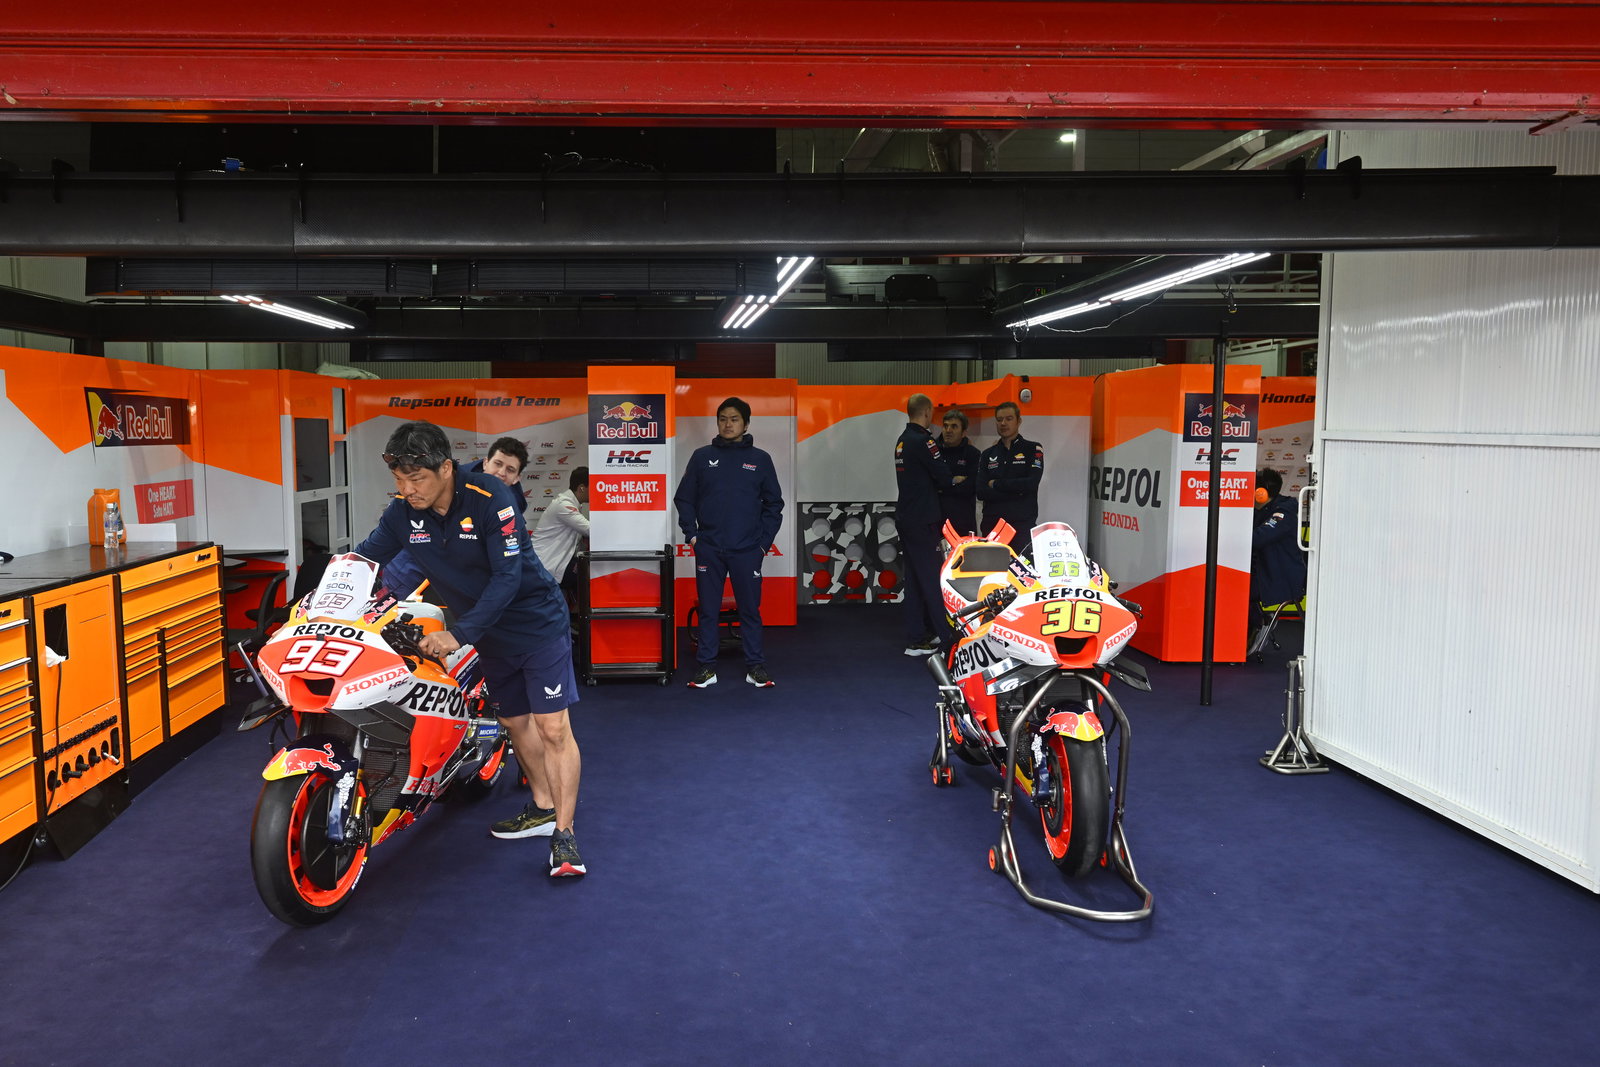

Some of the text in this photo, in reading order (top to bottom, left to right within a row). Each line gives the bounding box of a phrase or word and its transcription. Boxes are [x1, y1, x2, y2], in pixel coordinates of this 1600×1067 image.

[388, 395, 561, 409] Repsol Honda Team
[1261, 393, 1315, 403] Honda
[125, 405, 173, 439] Red Bull
[597, 422, 657, 438] Red Bull
[1191, 421, 1250, 437] Re Bull
[606, 450, 651, 464] HRC
[596, 481, 659, 492] One HEART.
[1089, 466, 1162, 508] REPSOL
[1187, 477, 1248, 489] One EART.
[148, 488, 159, 503] One
[606, 493, 652, 504] Satu HATI.
[1196, 489, 1210, 500] Sat
[1102, 511, 1139, 532] HONDA
[1049, 561, 1080, 577] 36
[326, 583, 354, 591] SOON
[1035, 587, 1103, 602] REPSOL
[315, 592, 354, 609] 93
[1041, 600, 1102, 635] 36
[293, 623, 365, 642] REPSOL
[992, 625, 1047, 654] HONDA
[278, 638, 364, 677] 93
[345, 666, 409, 695] HONDA
[397, 682, 468, 718] REPSOL
